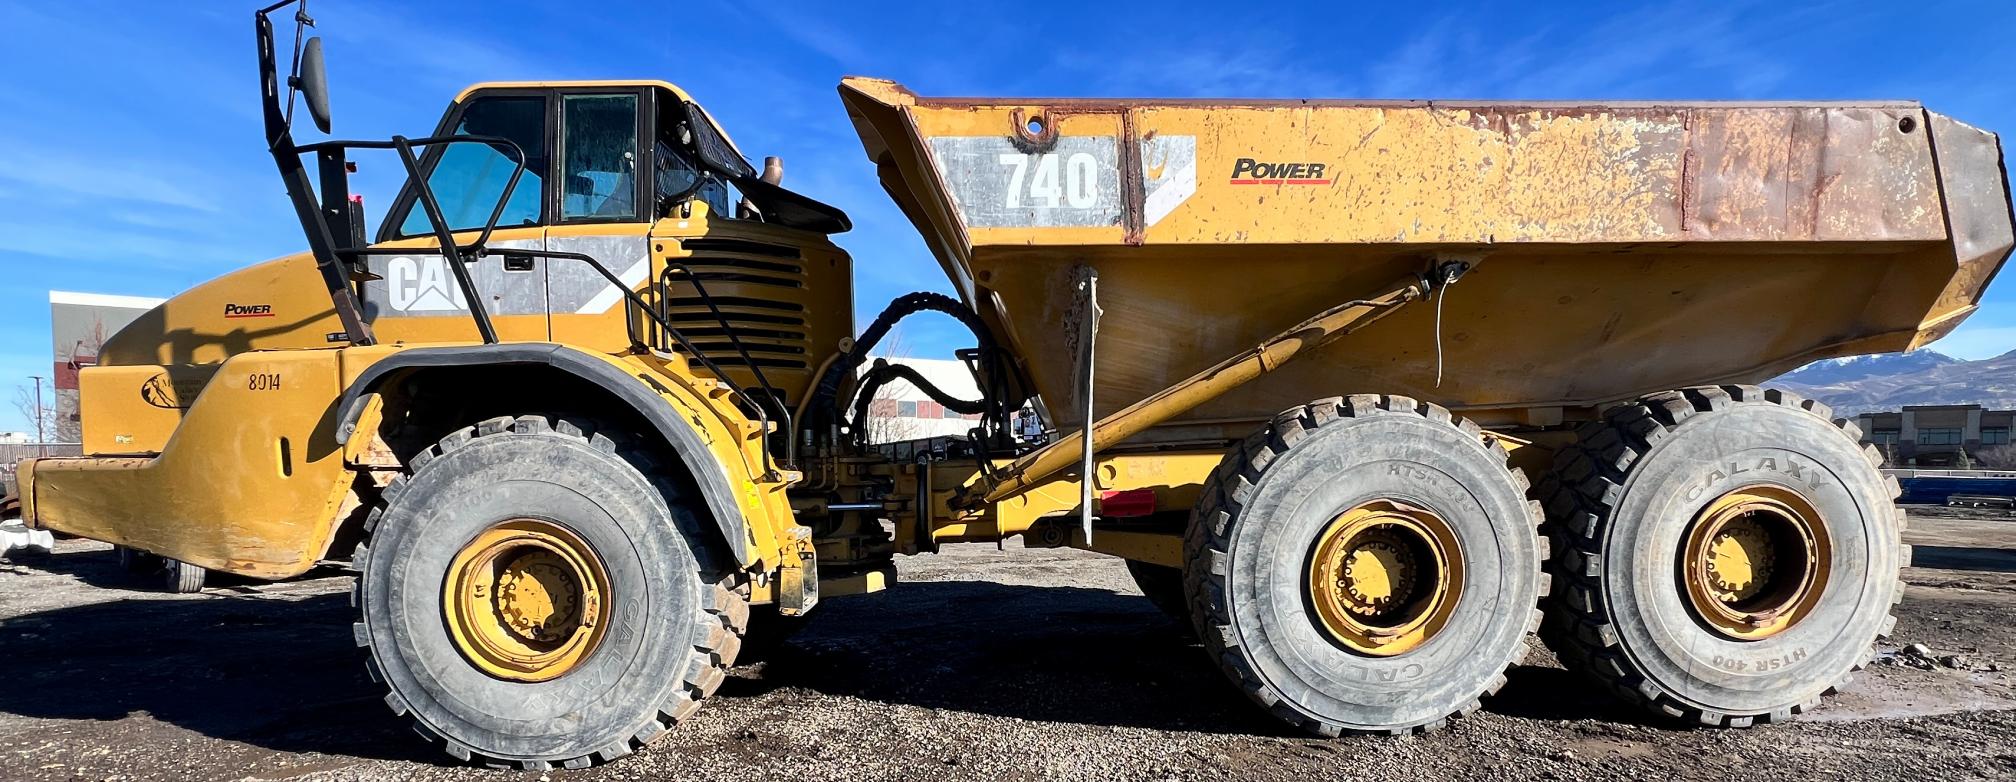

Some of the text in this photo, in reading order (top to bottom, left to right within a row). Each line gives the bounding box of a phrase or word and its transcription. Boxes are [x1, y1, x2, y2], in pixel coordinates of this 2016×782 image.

[999, 152, 1098, 209] 740
[388, 256, 473, 311] CAT
[248, 373, 281, 391] 8014
[1712, 647, 1808, 672] HTSR 400
